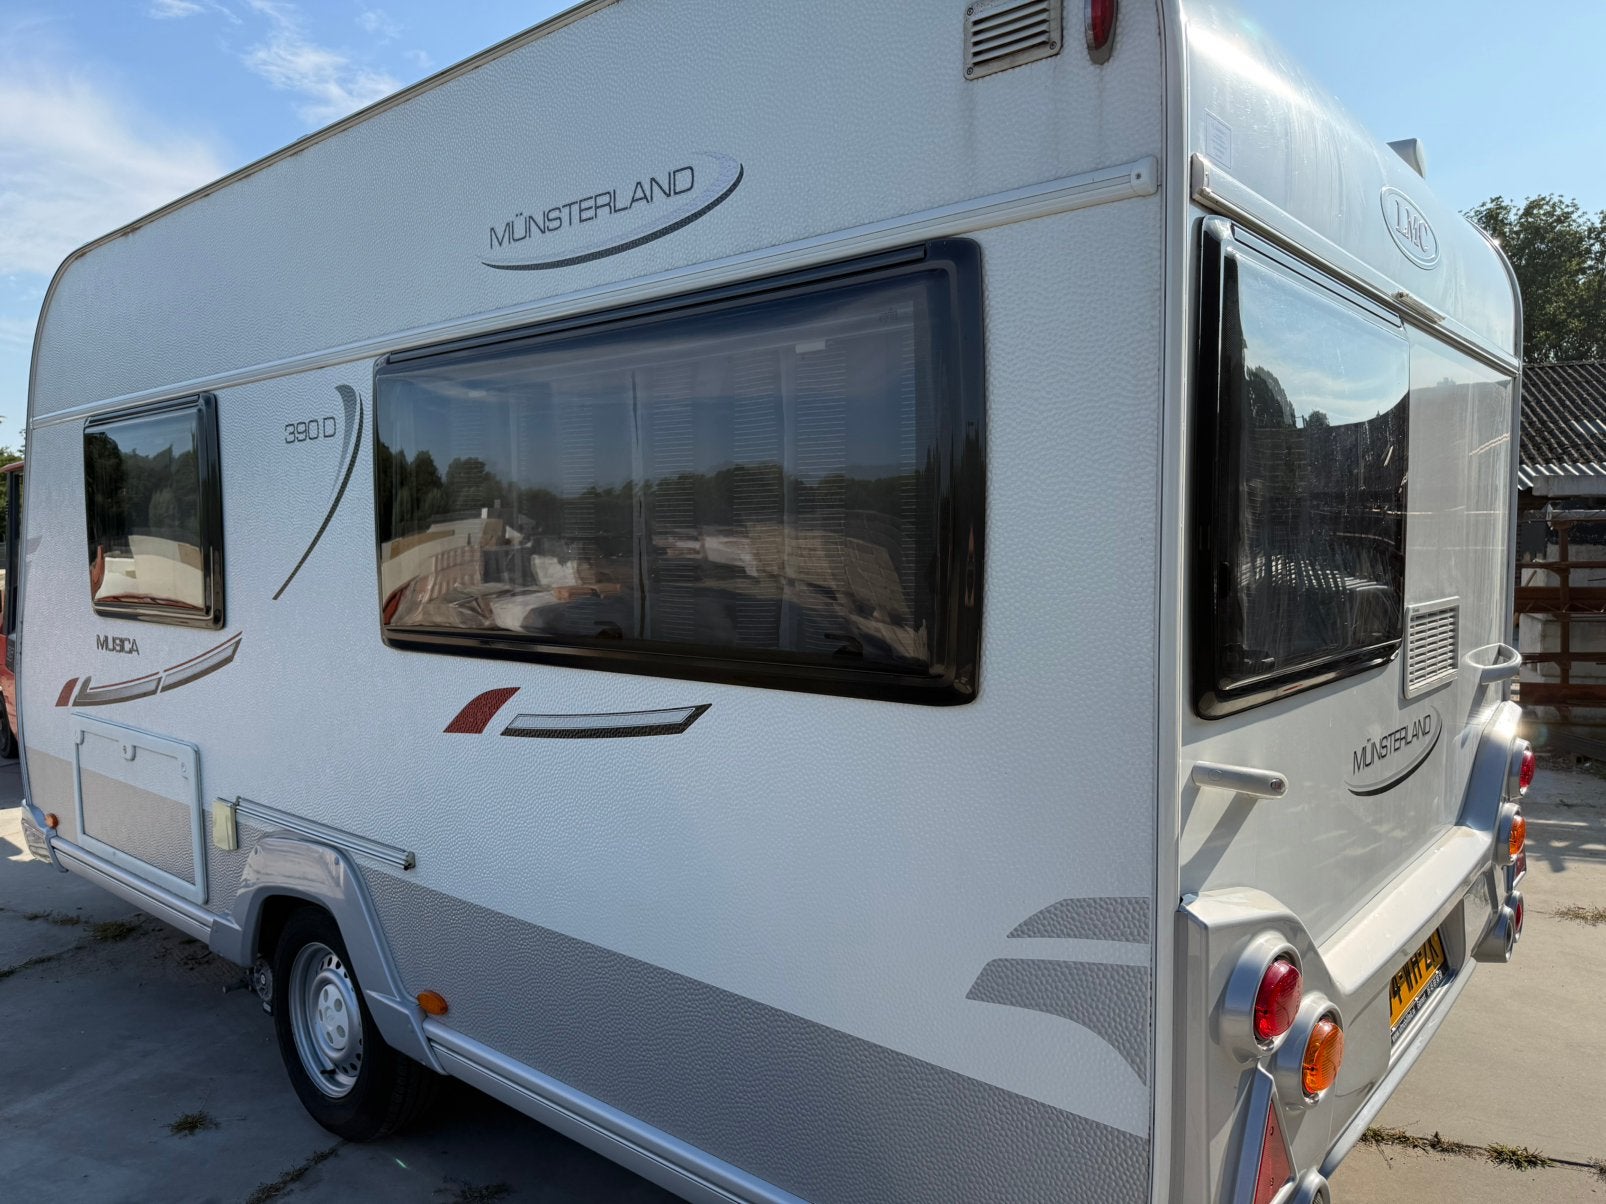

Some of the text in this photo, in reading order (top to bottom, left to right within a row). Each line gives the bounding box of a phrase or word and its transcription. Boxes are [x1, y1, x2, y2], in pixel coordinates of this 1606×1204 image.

[489, 165, 695, 249] MÜNSTERLAND
[1395, 199, 1428, 253] LMC
[284, 416, 337, 444] 390 D
[96, 634, 140, 656] MUSICA
[1353, 714, 1432, 776] MÜNSTERLAND
